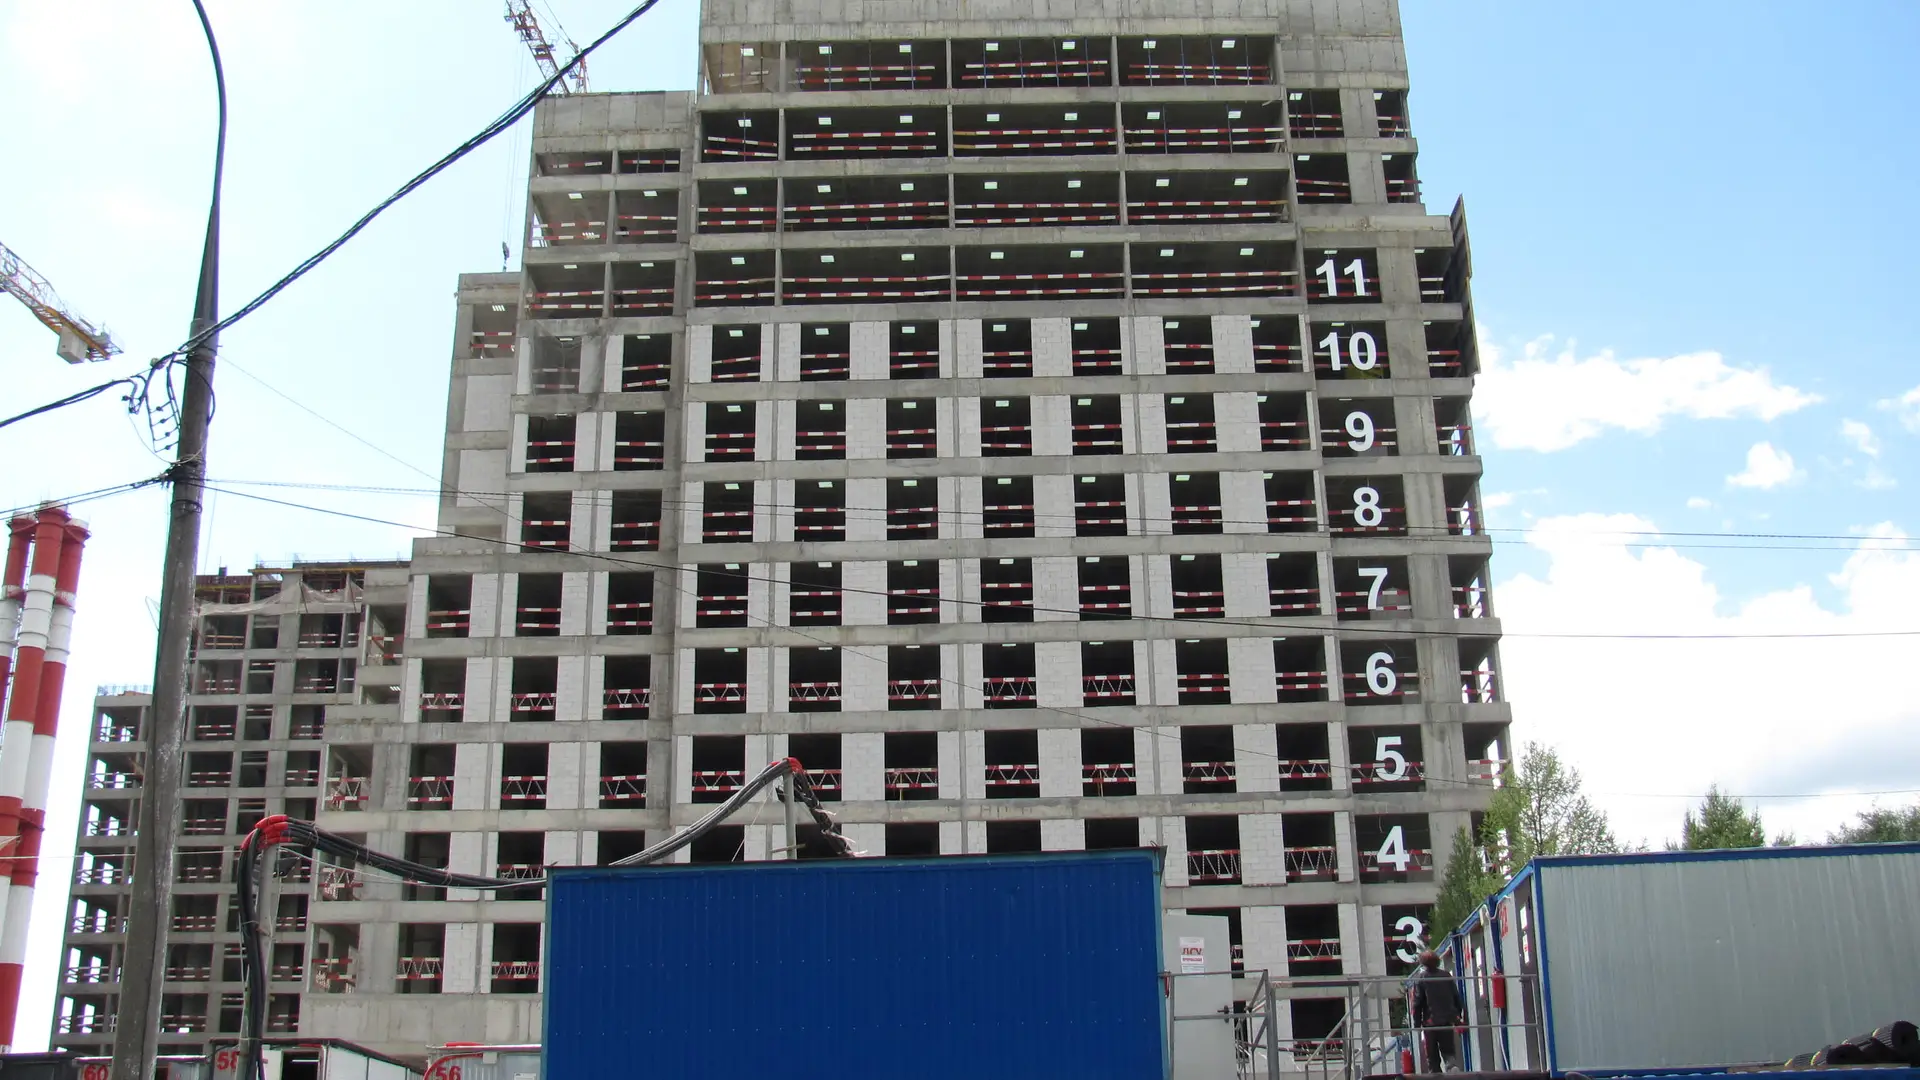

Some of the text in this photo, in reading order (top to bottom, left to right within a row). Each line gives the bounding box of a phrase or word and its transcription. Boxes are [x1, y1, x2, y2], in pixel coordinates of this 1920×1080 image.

[1316, 259, 1366, 296] 11
[1319, 332, 1377, 371] 10
[1345, 411, 1374, 452] 9
[1353, 487, 1382, 526] 8
[1358, 567, 1388, 610] 7
[1366, 652, 1396, 695] 6
[1375, 736, 1406, 781] 5
[1377, 826, 1410, 871] 4
[1395, 916, 1423, 963] 3
[84, 1064, 109, 1080] 60
[435, 1066, 462, 1080] 56
